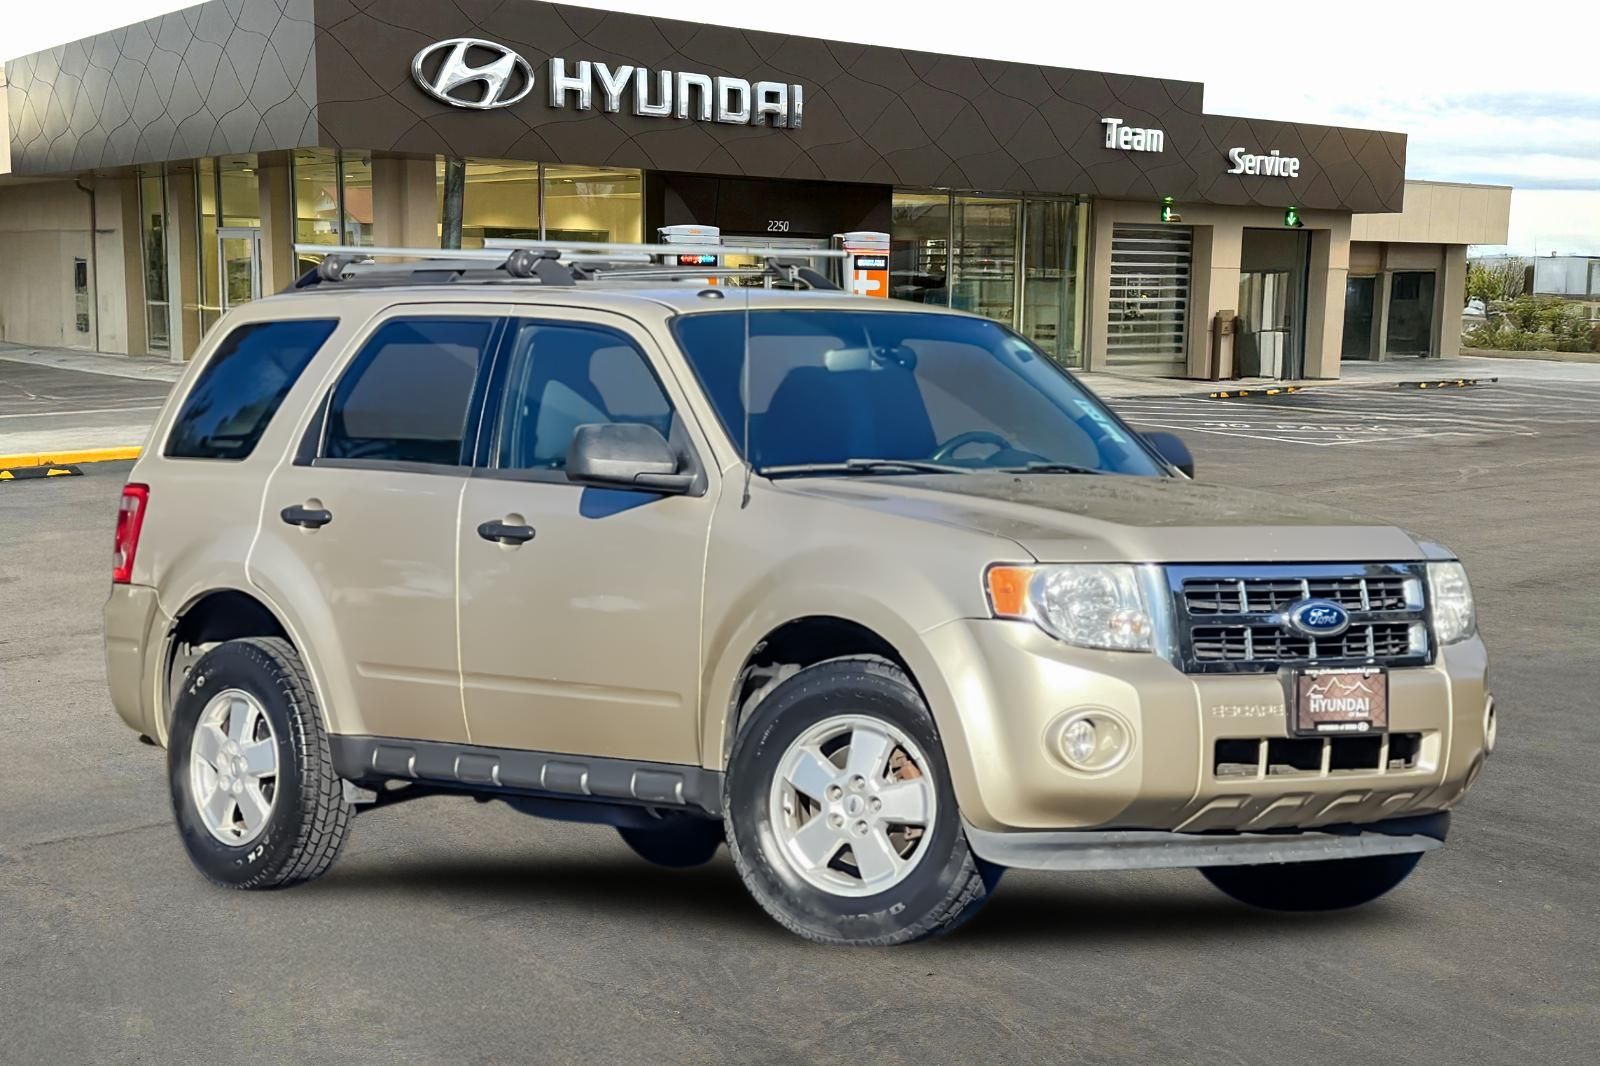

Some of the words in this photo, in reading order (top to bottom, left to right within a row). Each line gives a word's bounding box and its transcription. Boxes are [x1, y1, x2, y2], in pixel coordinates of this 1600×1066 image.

[548, 57, 804, 129] HYUNDAI
[1101, 117, 1164, 153] Team
[1227, 147, 1300, 178] Service
[767, 220, 790, 232] 2250
[1308, 608, 1338, 625] Ford
[1211, 703, 1284, 718] ESCAPE
[1309, 697, 1370, 713] HYUNDAI
